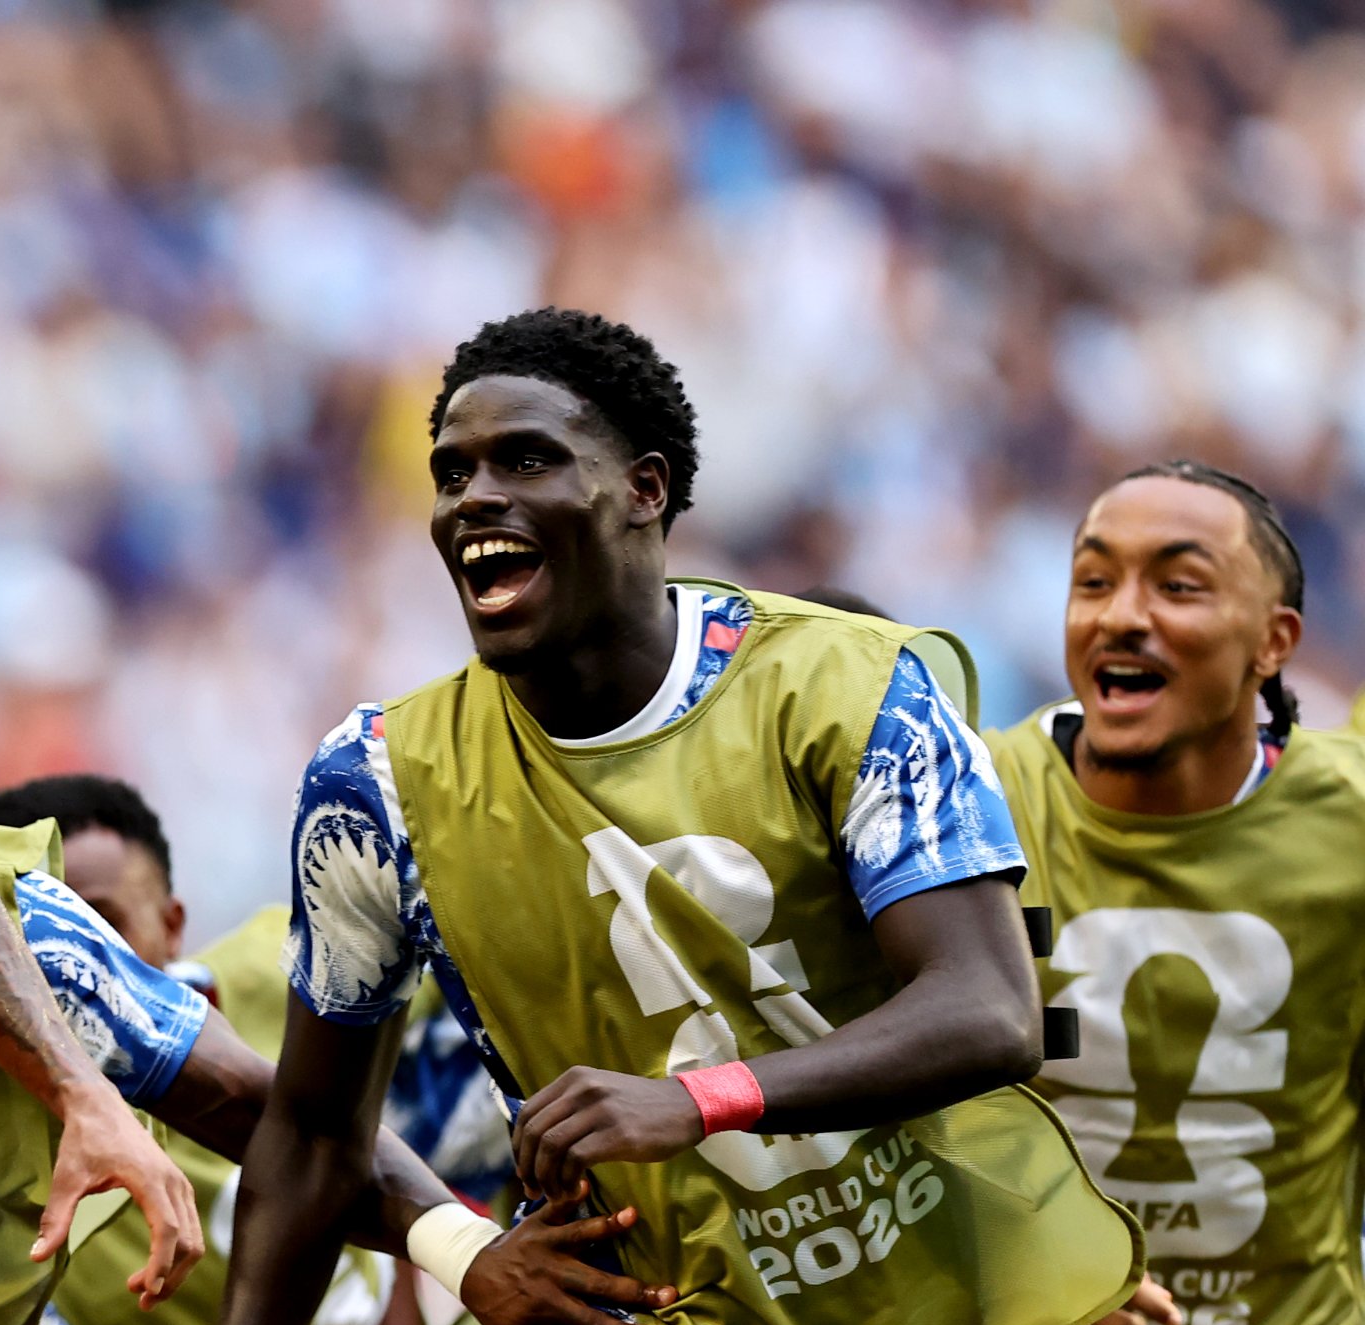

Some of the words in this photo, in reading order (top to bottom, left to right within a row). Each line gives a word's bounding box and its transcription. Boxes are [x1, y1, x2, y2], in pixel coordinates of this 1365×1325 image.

[733, 1175, 864, 1241] WORLD
[749, 1160, 945, 1300] 2026
[1125, 1200, 1200, 1232] FA
